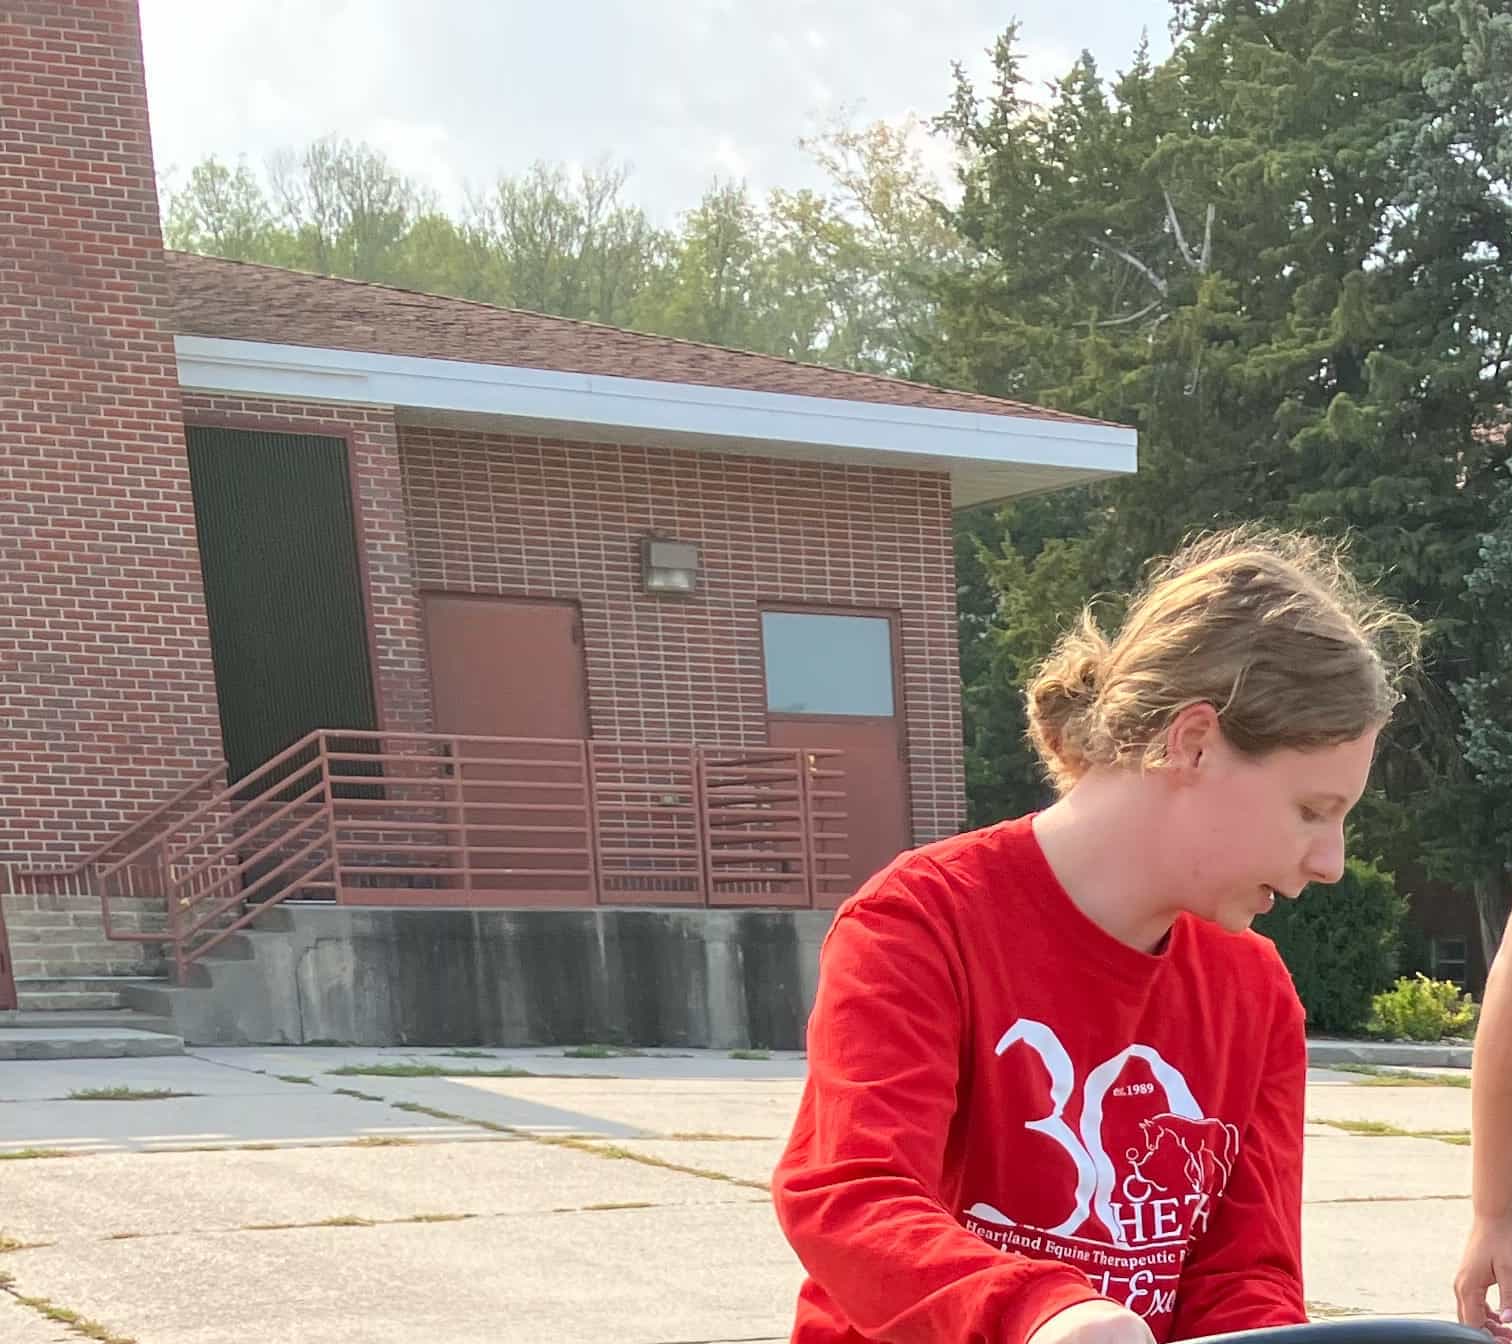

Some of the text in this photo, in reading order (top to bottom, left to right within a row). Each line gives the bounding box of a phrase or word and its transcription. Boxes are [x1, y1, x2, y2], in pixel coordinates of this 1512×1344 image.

[966, 1220, 1042, 1250] Heartland
[1045, 1240, 1091, 1262] Equine
[1092, 1250, 1176, 1270] Therapeutic
